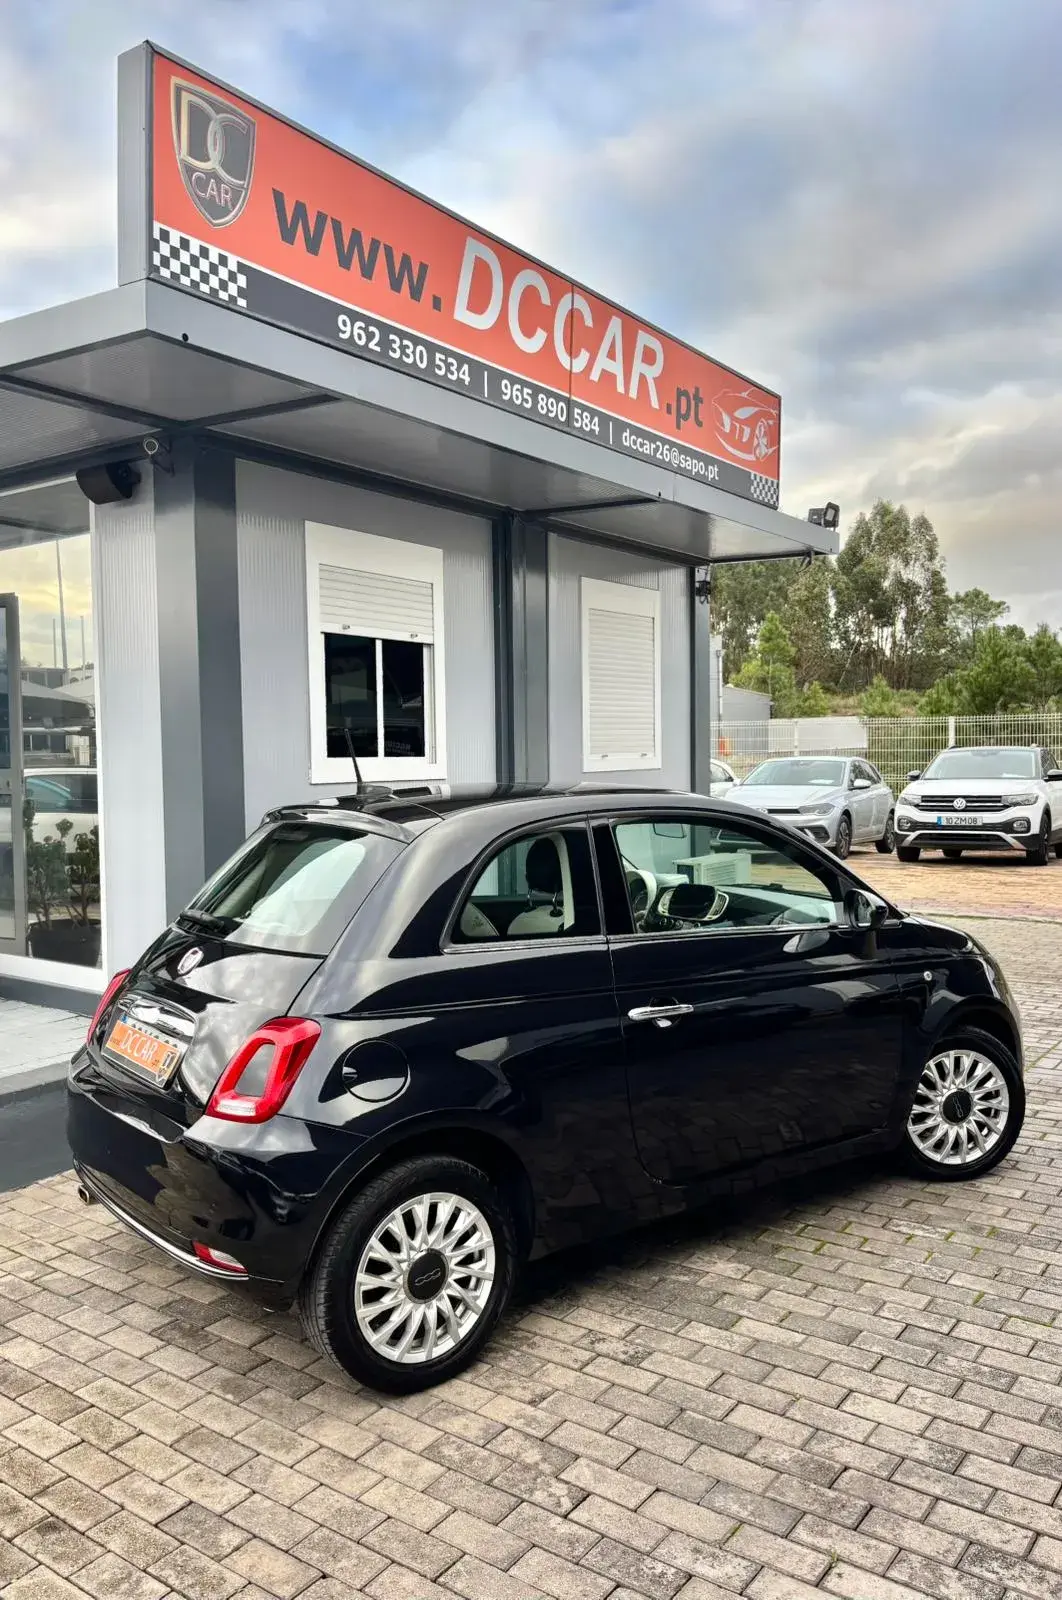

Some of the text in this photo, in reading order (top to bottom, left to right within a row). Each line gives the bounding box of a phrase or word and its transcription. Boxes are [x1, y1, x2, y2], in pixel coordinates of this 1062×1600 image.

[191, 172, 233, 210] CAR
[337, 314, 381, 352] 962
[388, 334, 428, 369] 330
[434, 352, 471, 386] 534
[501, 378, 533, 409] 965
[537, 393, 567, 423] 890
[573, 406, 600, 435] 584
[622, 429, 718, 480] dccar26@sapo.pt
